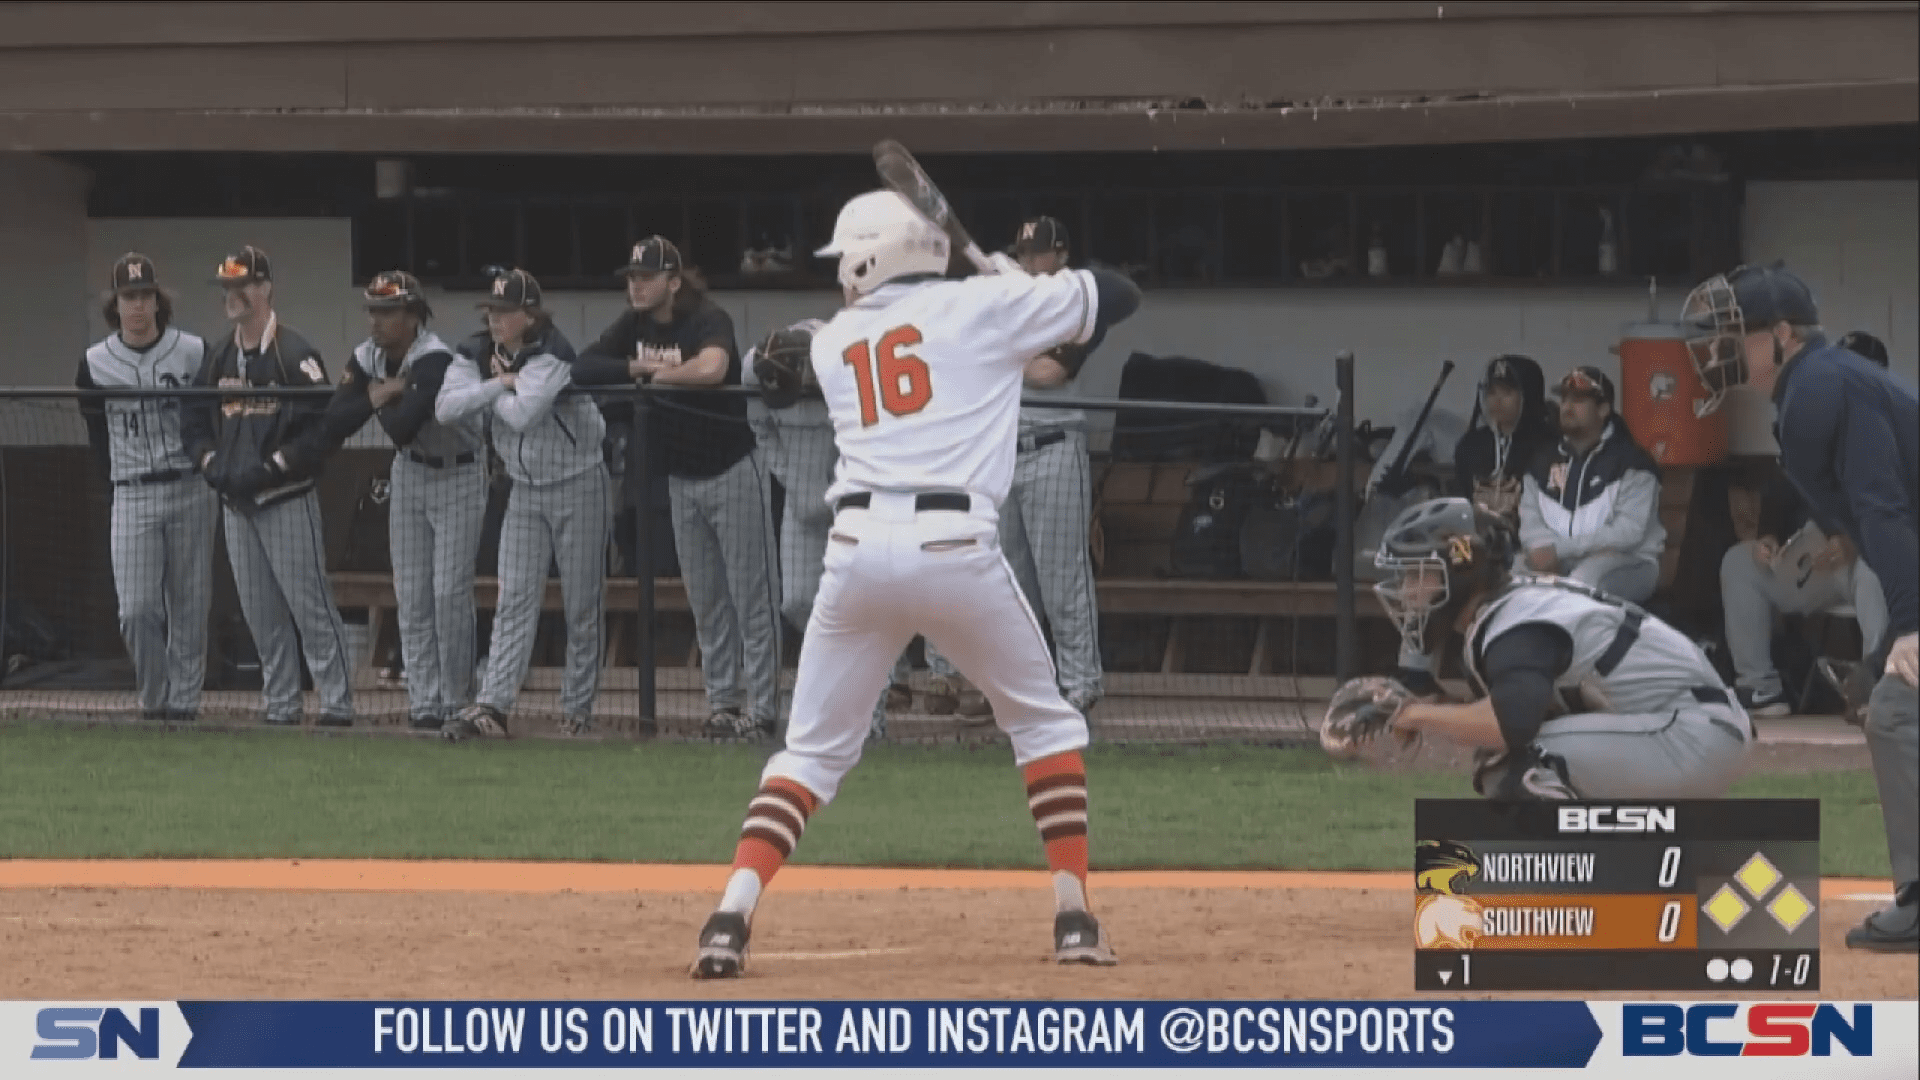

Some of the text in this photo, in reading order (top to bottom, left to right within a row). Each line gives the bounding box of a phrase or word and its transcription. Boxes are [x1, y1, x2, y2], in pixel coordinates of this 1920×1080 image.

[128, 263, 142, 280] N
[494, 279, 508, 297] N
[842, 324, 933, 428] 16
[1449, 535, 1472, 564] N
